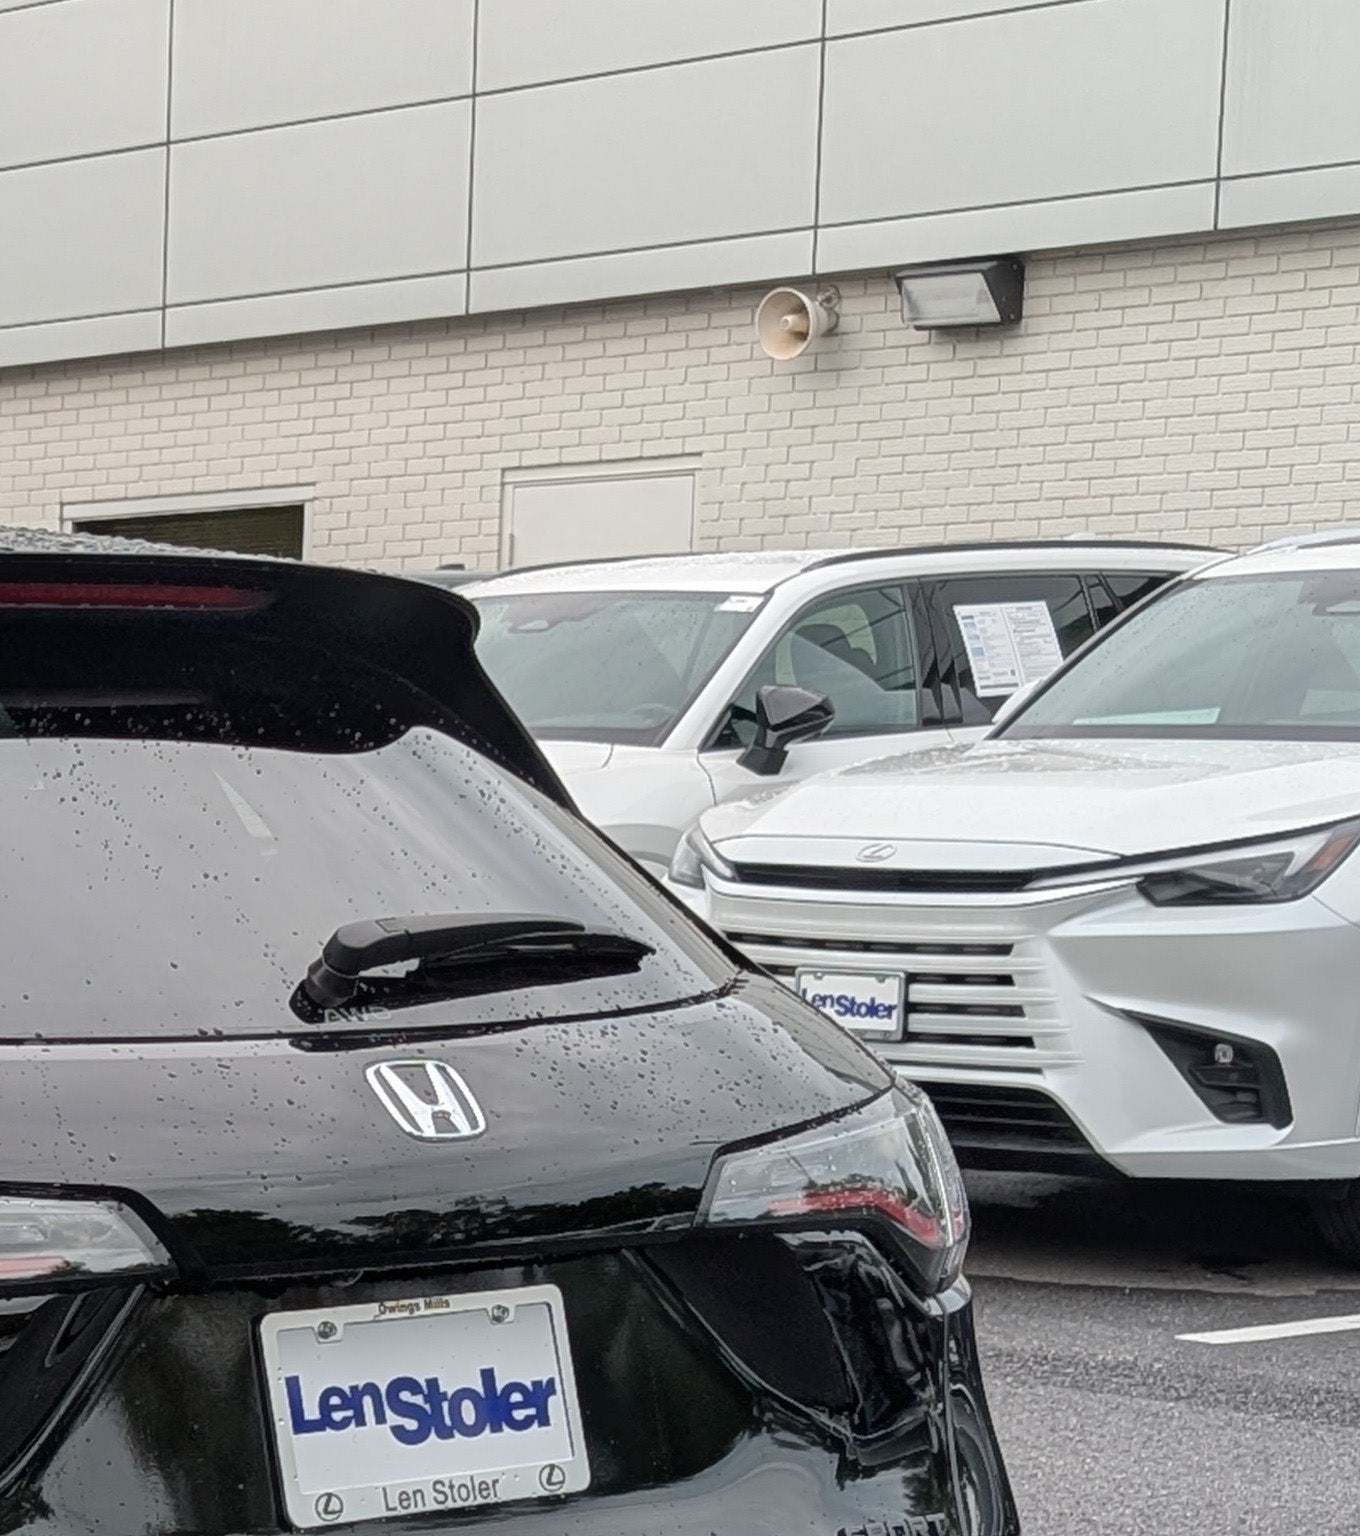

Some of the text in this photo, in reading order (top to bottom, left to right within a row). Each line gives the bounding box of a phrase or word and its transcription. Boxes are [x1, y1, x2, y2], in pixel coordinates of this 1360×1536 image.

[323, 1006, 392, 1024] AWD
[382, 1475, 499, 1512] Len Stoler
